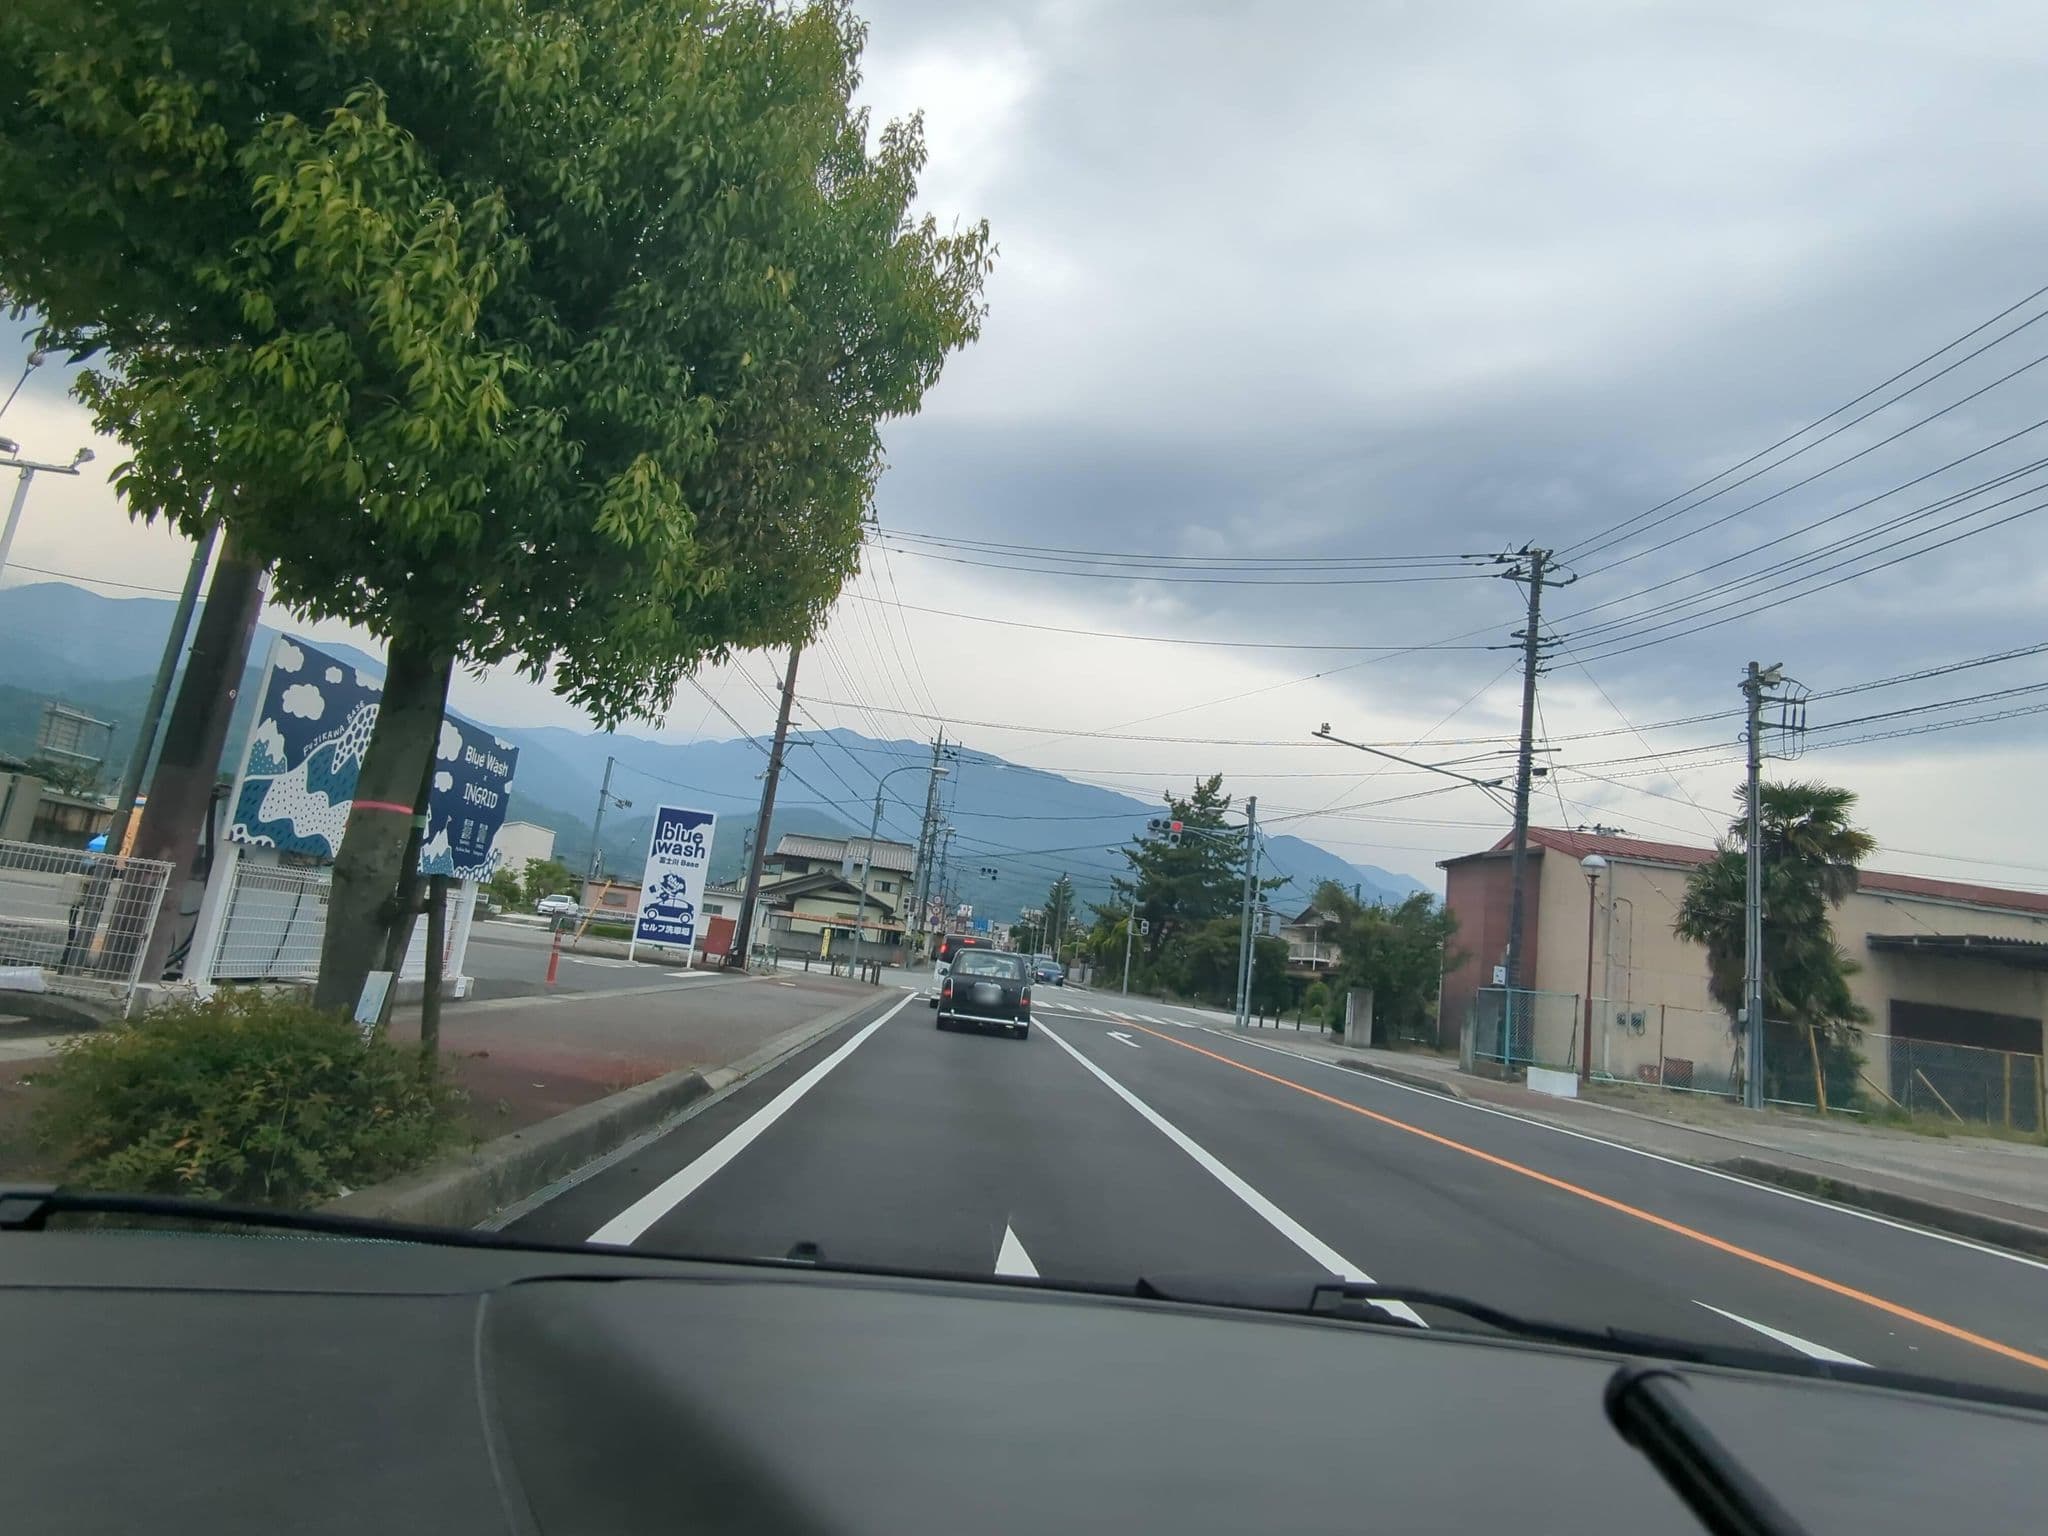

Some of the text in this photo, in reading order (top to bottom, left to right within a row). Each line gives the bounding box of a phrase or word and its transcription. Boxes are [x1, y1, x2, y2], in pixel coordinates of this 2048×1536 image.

[303, 700, 365, 757] FUJIKAWA BASE
[465, 745, 509, 777] Blue Wash
[463, 783, 498, 809] INGRID
[663, 822, 704, 844] blue
[657, 840, 706, 859] wash
